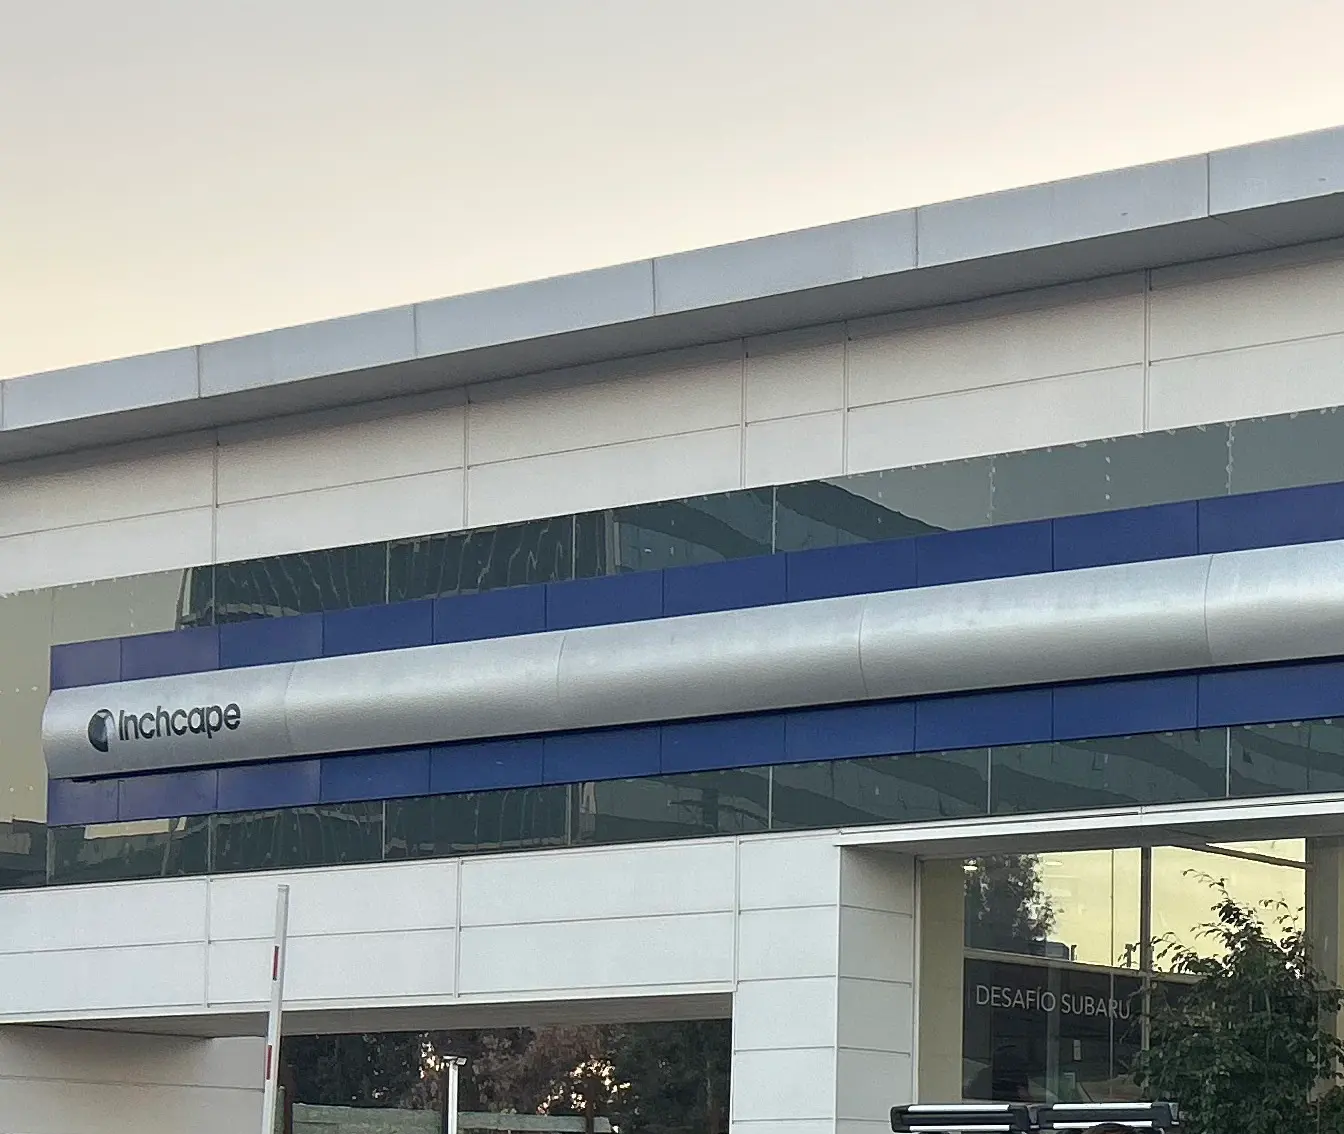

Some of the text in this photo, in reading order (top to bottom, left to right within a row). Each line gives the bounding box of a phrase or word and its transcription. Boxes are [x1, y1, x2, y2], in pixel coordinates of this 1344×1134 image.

[118, 703, 241, 741] Inchcape
[976, 985, 1131, 1019] DESAFÍO SUBARU
